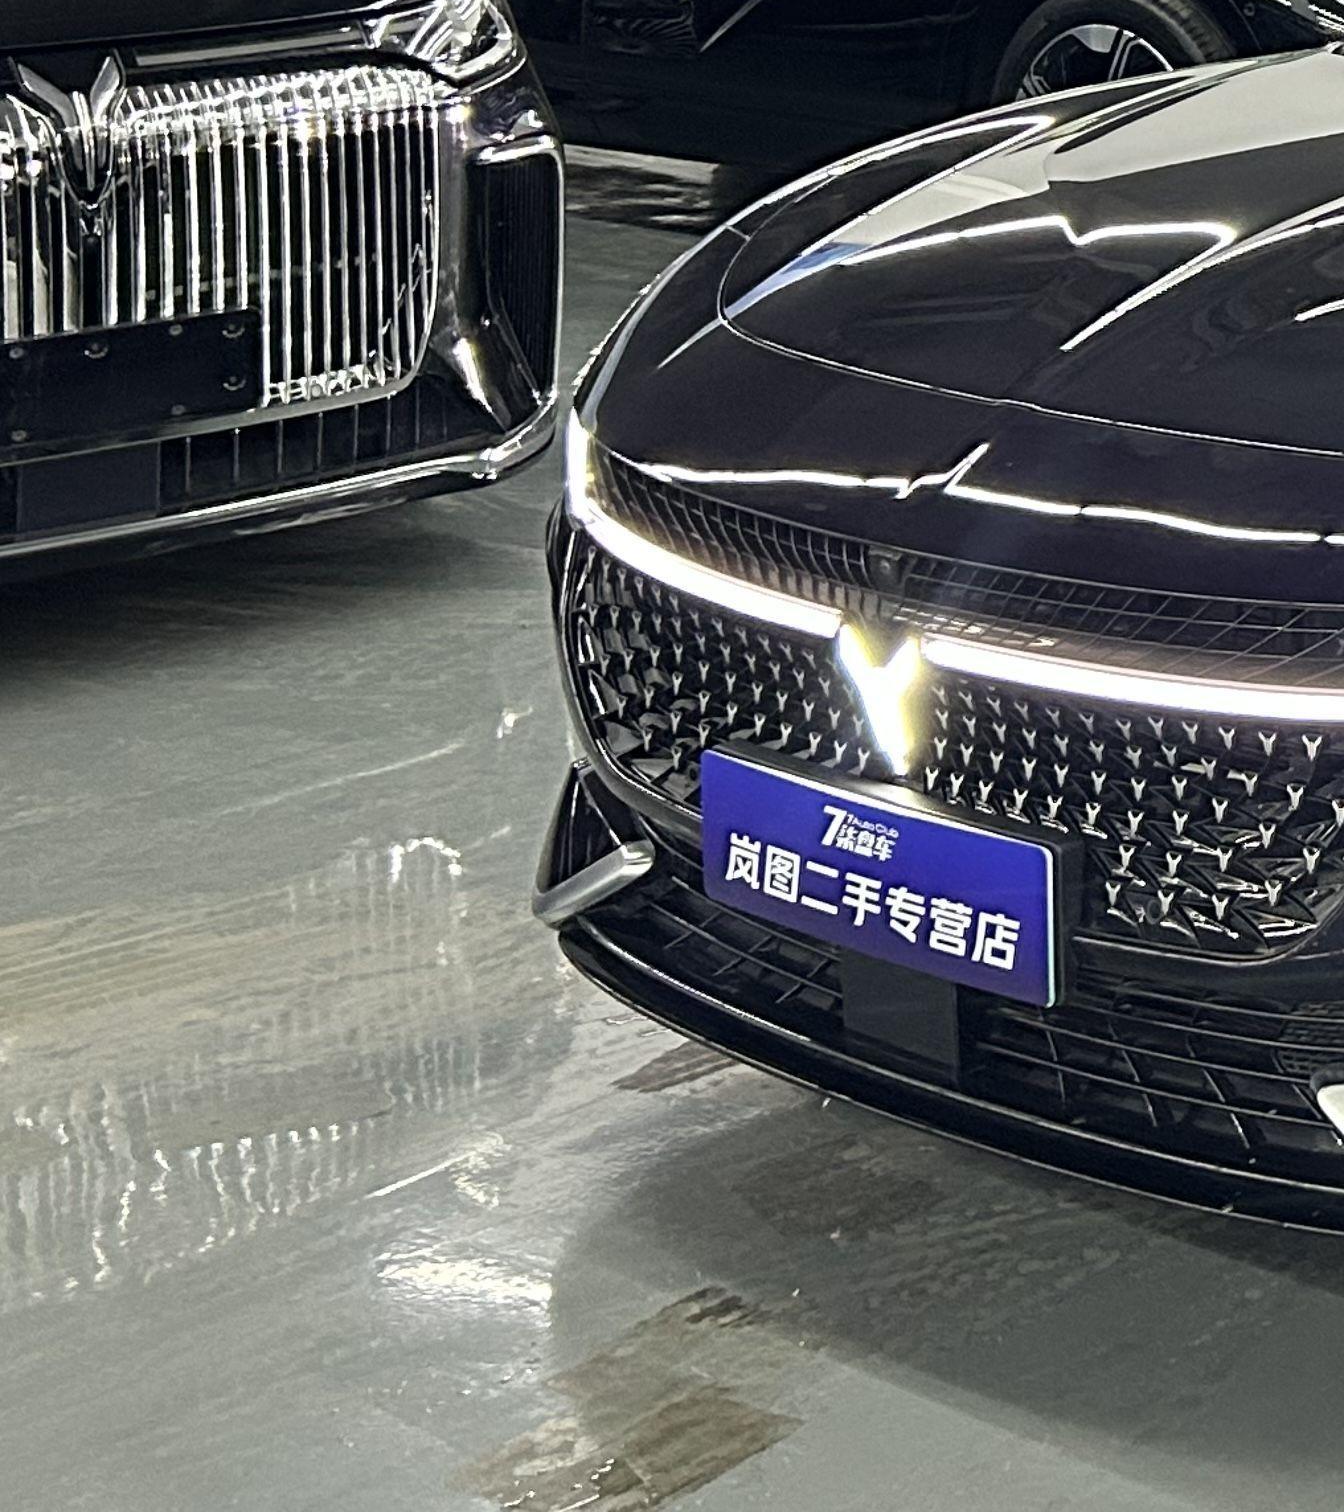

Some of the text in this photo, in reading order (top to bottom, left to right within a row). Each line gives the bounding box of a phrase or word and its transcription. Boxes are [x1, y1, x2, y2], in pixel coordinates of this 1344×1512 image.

[725, 833, 1021, 970] 岚图二手专营店
